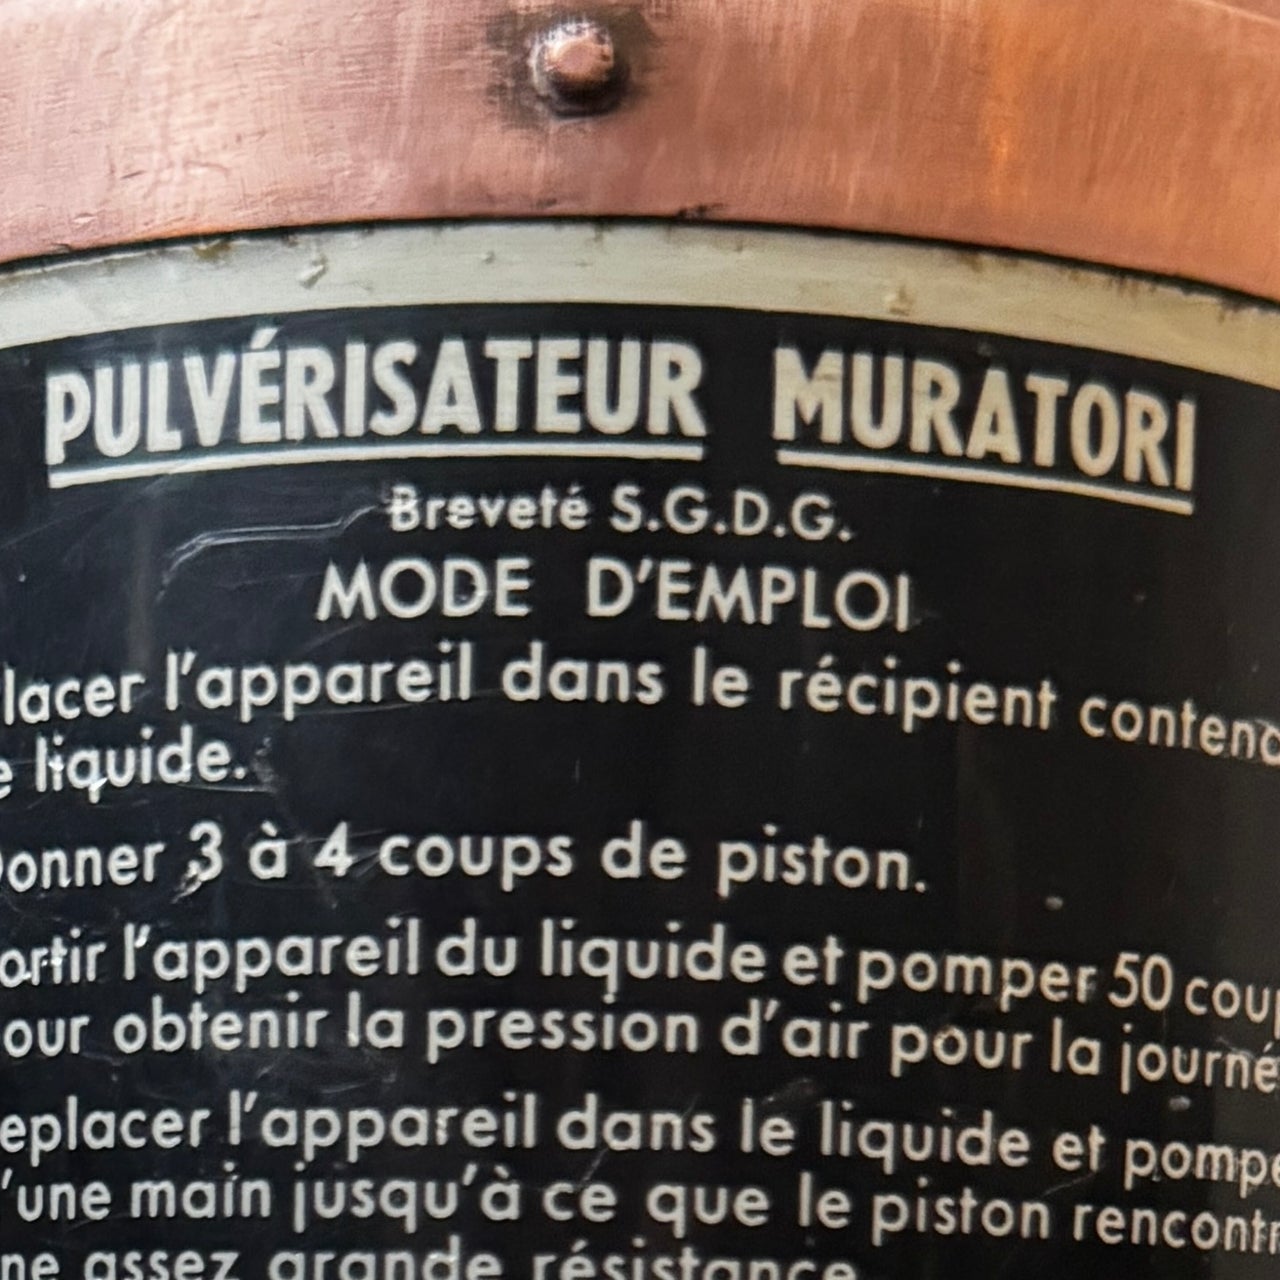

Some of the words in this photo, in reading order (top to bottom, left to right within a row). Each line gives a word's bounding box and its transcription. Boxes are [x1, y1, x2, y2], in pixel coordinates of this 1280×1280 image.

[45, 329, 707, 465] PULVÉRISATEUR
[773, 345, 1197, 492] MURATORI
[385, 485, 588, 531] Breveté
[611, 485, 851, 541] S.G.D.G.
[317, 558, 530, 620] MODE
[588, 558, 908, 631] D'EMPLOI
[166, 642, 471, 722] l'appareil
[502, 641, 663, 704] dans
[694, 647, 748, 707] le
[780, 655, 1056, 732] récipient
[36, 724, 245, 803] liquide.
[186, 822, 222, 882] 3
[250, 822, 287, 879] à
[314, 822, 356, 876] 4
[378, 836, 572, 891] coups
[602, 820, 686, 879] de
[719, 824, 925, 897] piston.
[125, 917, 418, 994] l'appareil
[437, 918, 516, 976] du
[542, 919, 765, 994] liquide
[783, 936, 844, 985] et
[859, 951, 1096, 1011] pomper
[1109, 952, 1173, 1010] 50
[114, 991, 328, 1053] obtenir
[347, 991, 404, 1048] la
[427, 996, 697, 1064] pression
[722, 999, 869, 1058] d'air
[892, 1025, 1032, 1076] pour
[1052, 1017, 1100, 1074] la
[230, 1090, 536, 1163] l'appareil
[557, 1093, 714, 1152] dans
[742, 1098, 795, 1155] le
[822, 1101, 1030, 1174] liquide
[1054, 1126, 1105, 1170] et
[131, 1162, 270, 1218] main
[294, 1162, 520, 1233] jusqu'à
[544, 1176, 616, 1221] ce
[647, 1184, 768, 1238] que
[800, 1172, 850, 1228] le
[873, 1177, 1049, 1246] piston
